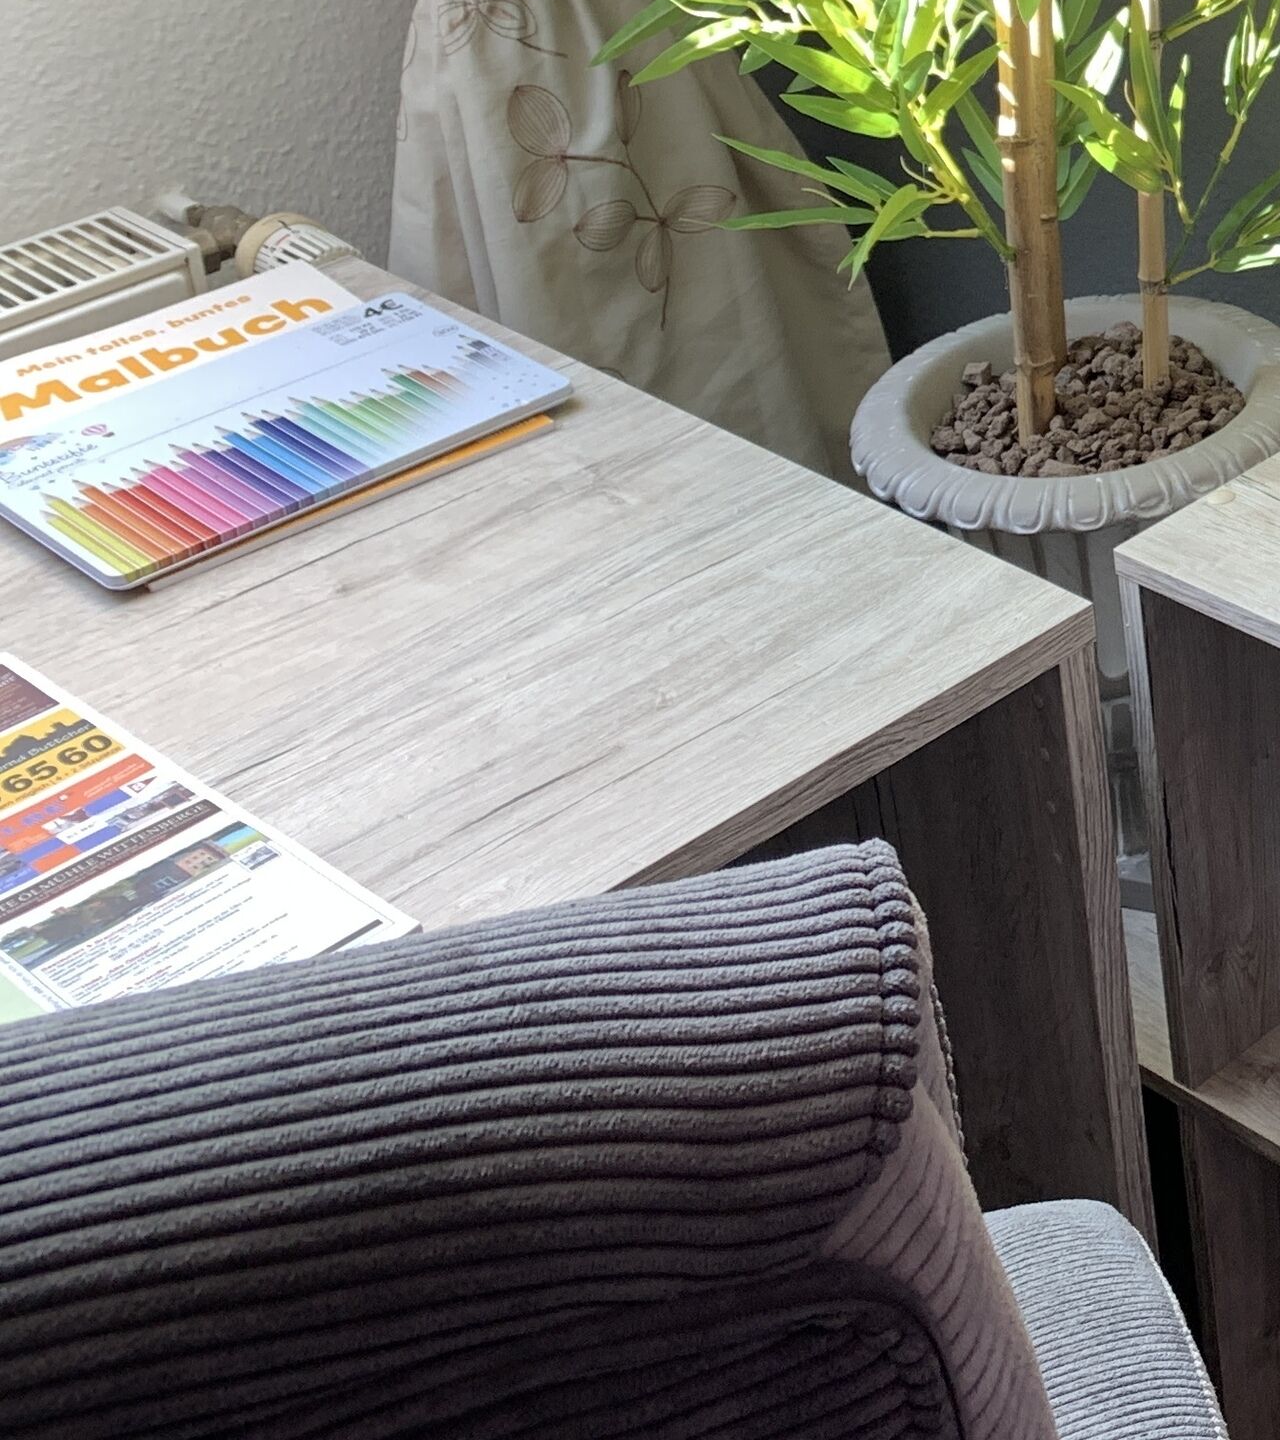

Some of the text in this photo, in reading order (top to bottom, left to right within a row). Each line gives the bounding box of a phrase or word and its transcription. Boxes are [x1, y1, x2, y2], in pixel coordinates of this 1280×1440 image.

[0, 297, 333, 421] Malbuch
[17, 353, 82, 377] Mein
[167, 295, 252, 329] buntes
